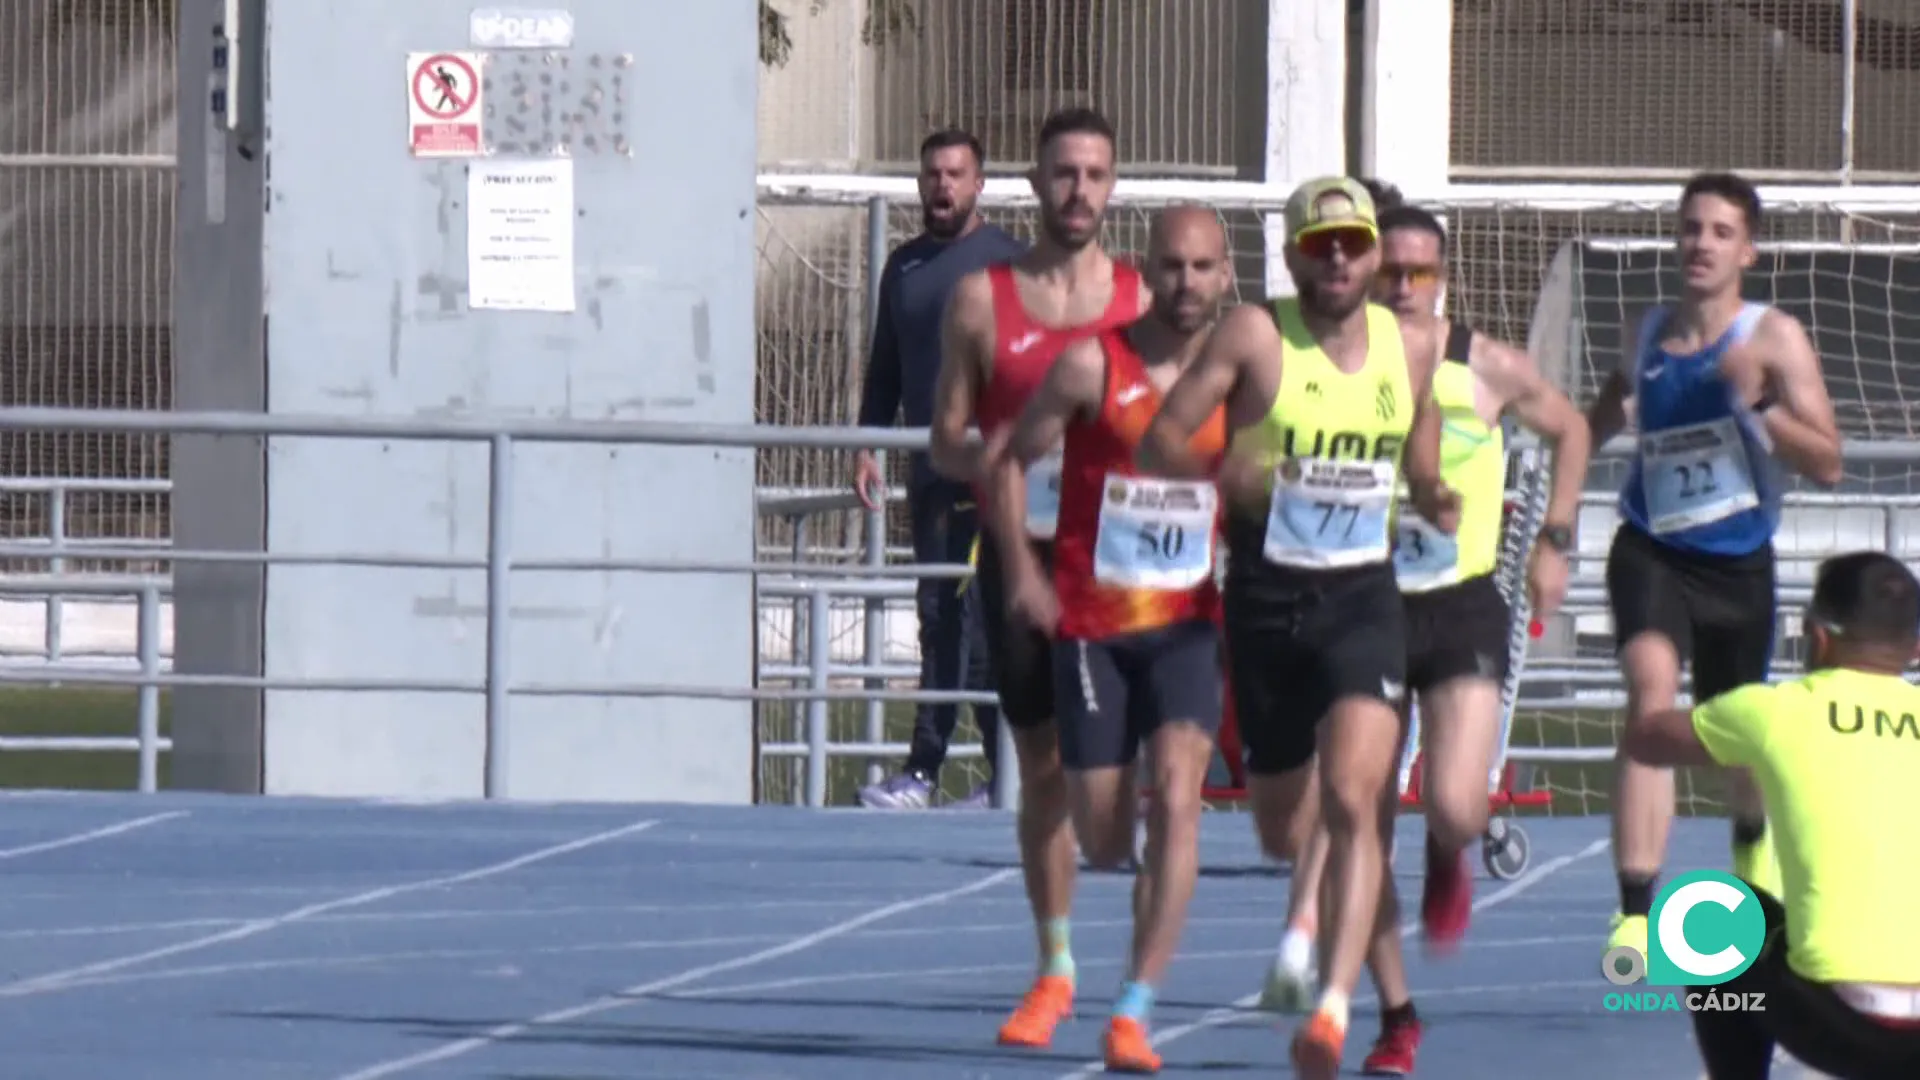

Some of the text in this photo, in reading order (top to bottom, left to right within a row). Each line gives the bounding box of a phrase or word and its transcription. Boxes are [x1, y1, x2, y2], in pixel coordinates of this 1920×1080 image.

[1673, 461, 1717, 498] 22
[1136, 521, 1184, 560] 50
[1314, 502, 1361, 541] 77
